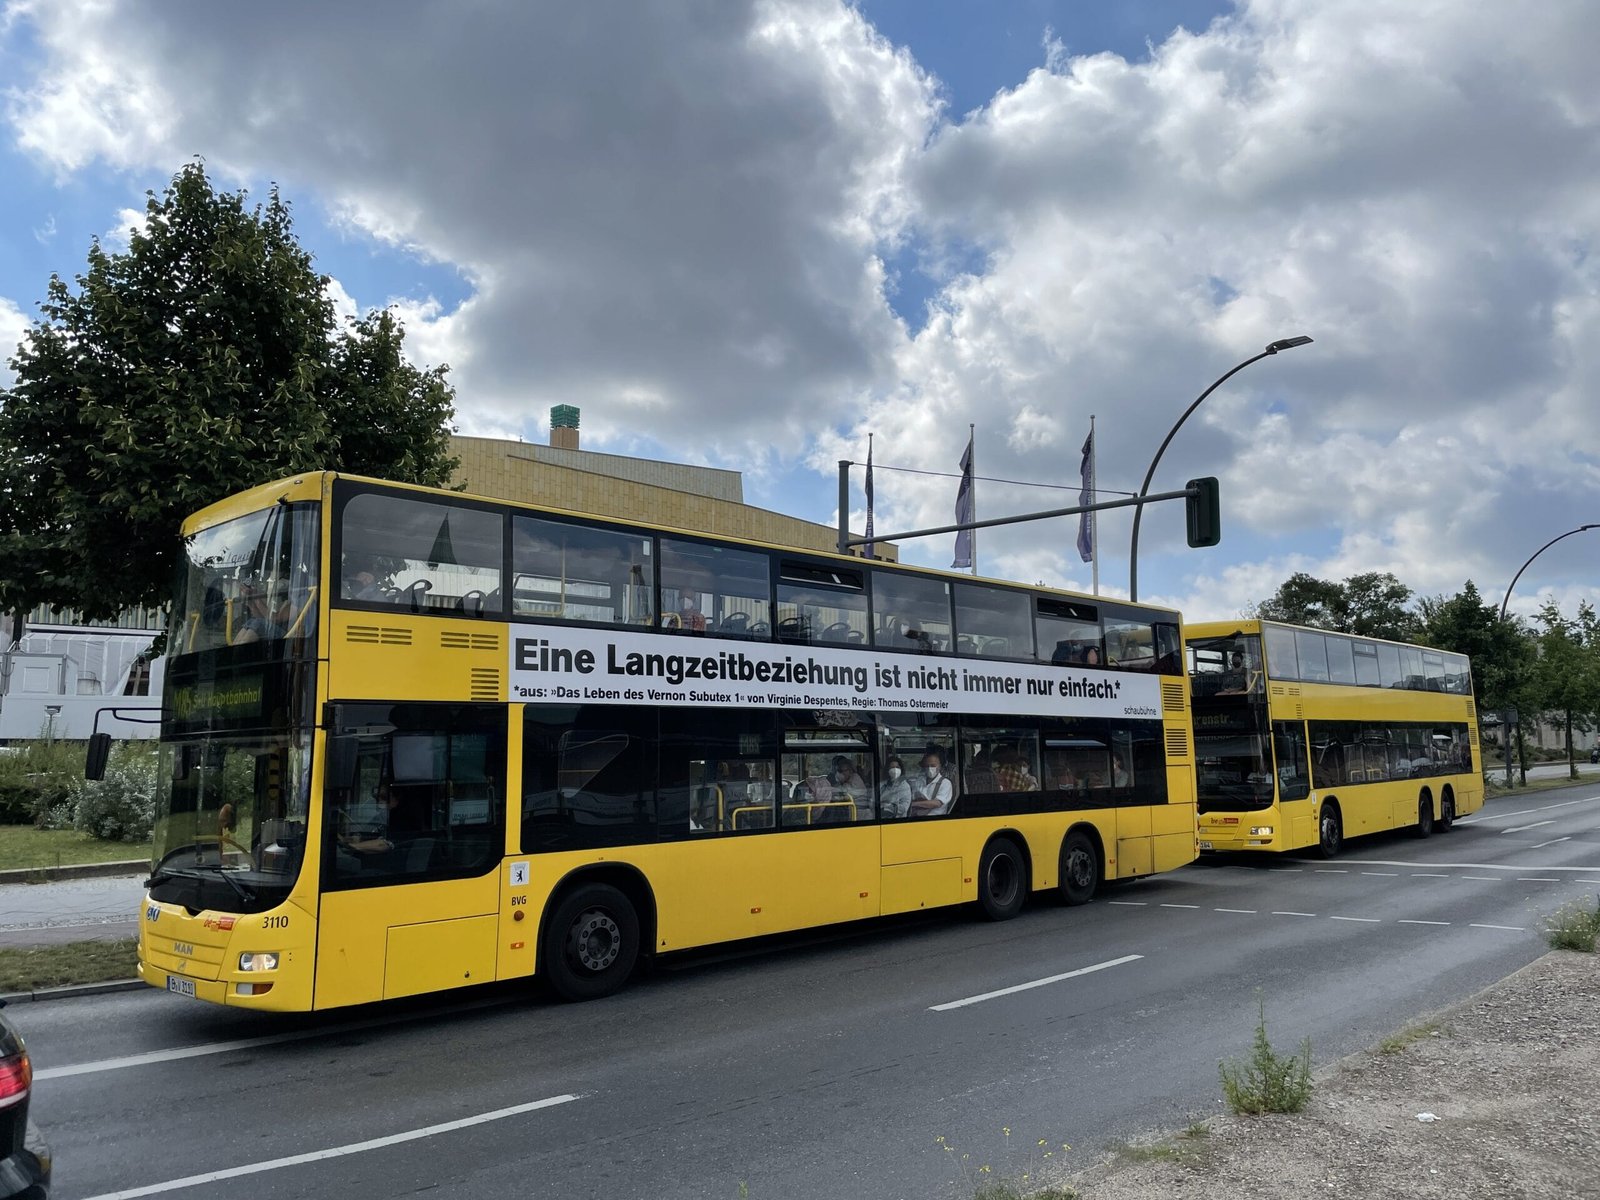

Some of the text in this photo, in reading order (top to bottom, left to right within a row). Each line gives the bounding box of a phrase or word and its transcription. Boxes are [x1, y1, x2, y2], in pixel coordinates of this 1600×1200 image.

[515, 637, 595, 673] Eine
[607, 643, 867, 692] Langzeitbeziehung
[875, 662, 901, 688] ist
[908, 665, 958, 691] nicht
[963, 669, 1021, 695] immer
[1027, 678, 1054, 696] nur
[584, 687, 620, 699] Leben
[624, 689, 644, 700] des
[647, 689, 686, 701] Vernon
[689, 690, 731, 702] Subutex
[747, 694, 764, 704] von
[767, 694, 801, 706] Virginie
[804, 695, 850, 707] Despentes,
[852, 696, 877, 708] Regie:
[878, 697, 908, 708] Thomas
[909, 698, 949, 709] Ostermeier
[1124, 705, 1157, 716] schaubühne
[511, 895, 527, 906] BVG
[262, 916, 289, 929] 3110
[174, 942, 194, 956] MAN
